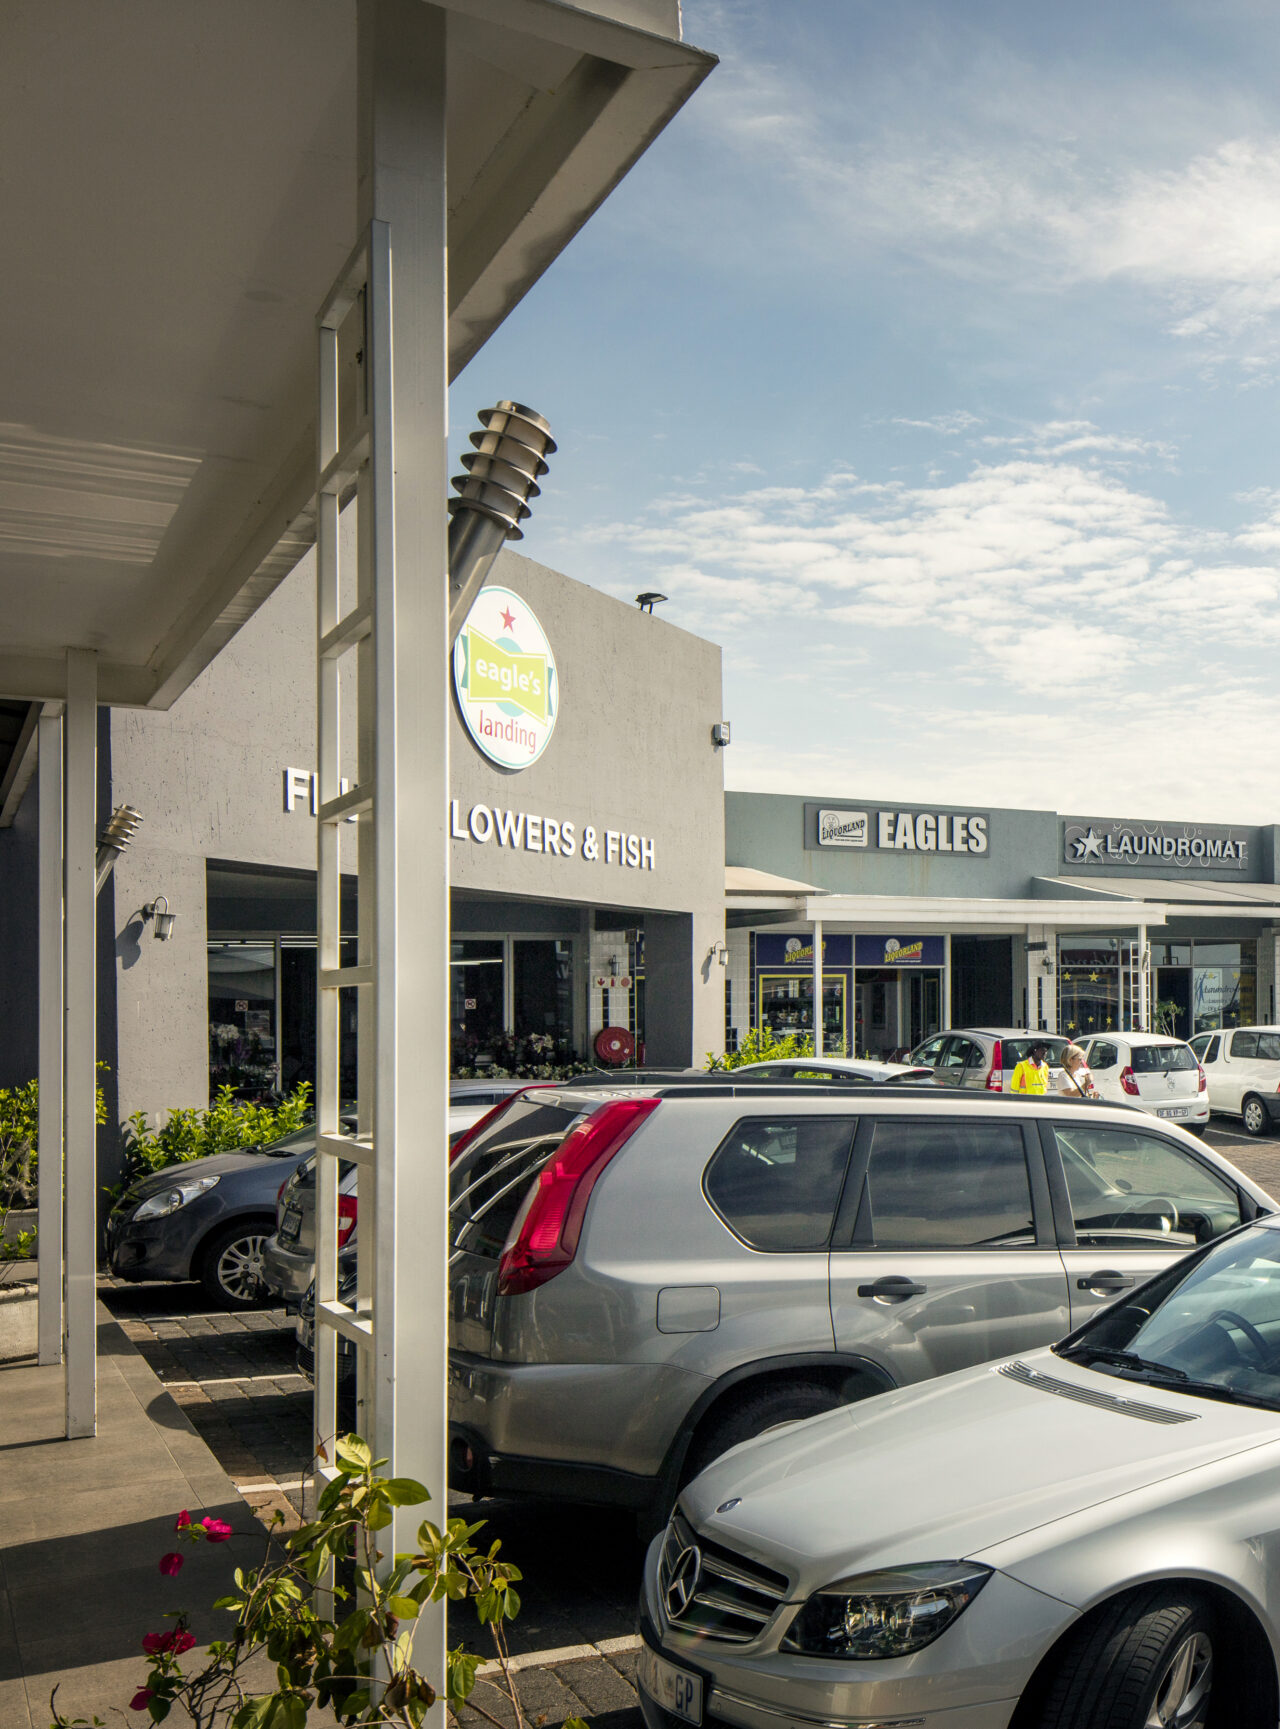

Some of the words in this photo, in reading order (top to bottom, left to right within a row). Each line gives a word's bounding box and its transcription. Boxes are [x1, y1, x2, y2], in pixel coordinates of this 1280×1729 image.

[476, 658, 541, 695] eagle's
[480, 709, 536, 754] landing
[451, 799, 576, 857] LOWERS
[582, 825, 599, 861] &
[605, 830, 655, 870] FISH
[822, 819, 865, 840] LIQUORLAND
[878, 811, 987, 853] EAGLES
[1106, 834, 1246, 858] LAUNDROMAT
[785, 941, 826, 963] LIQUORLD
[884, 942, 923, 963] LIQUORLAND
[675, 1673, 693, 1713] GP
